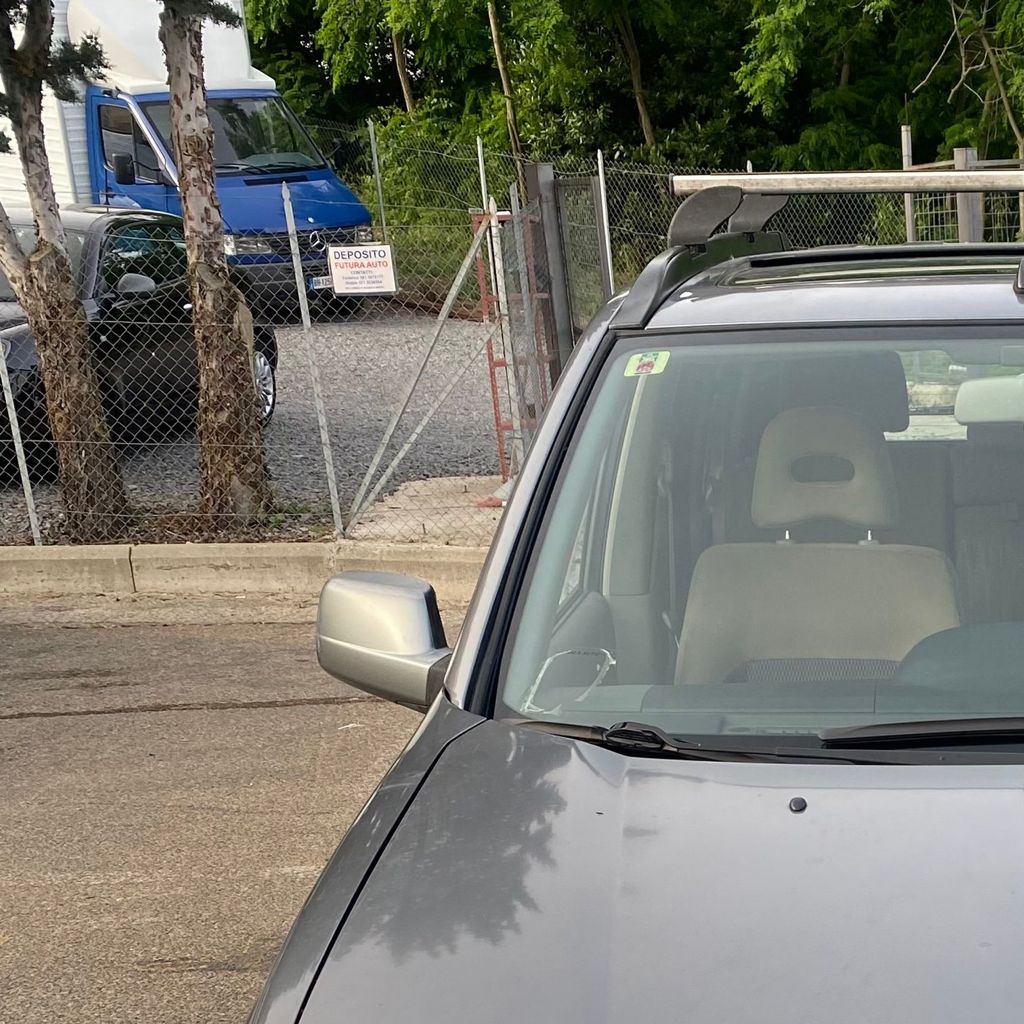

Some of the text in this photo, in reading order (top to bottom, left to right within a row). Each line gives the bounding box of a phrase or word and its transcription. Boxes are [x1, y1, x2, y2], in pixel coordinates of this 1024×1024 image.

[334, 250, 386, 260] DEPOSITO
[334, 260, 388, 269] FUTURA AUTO
